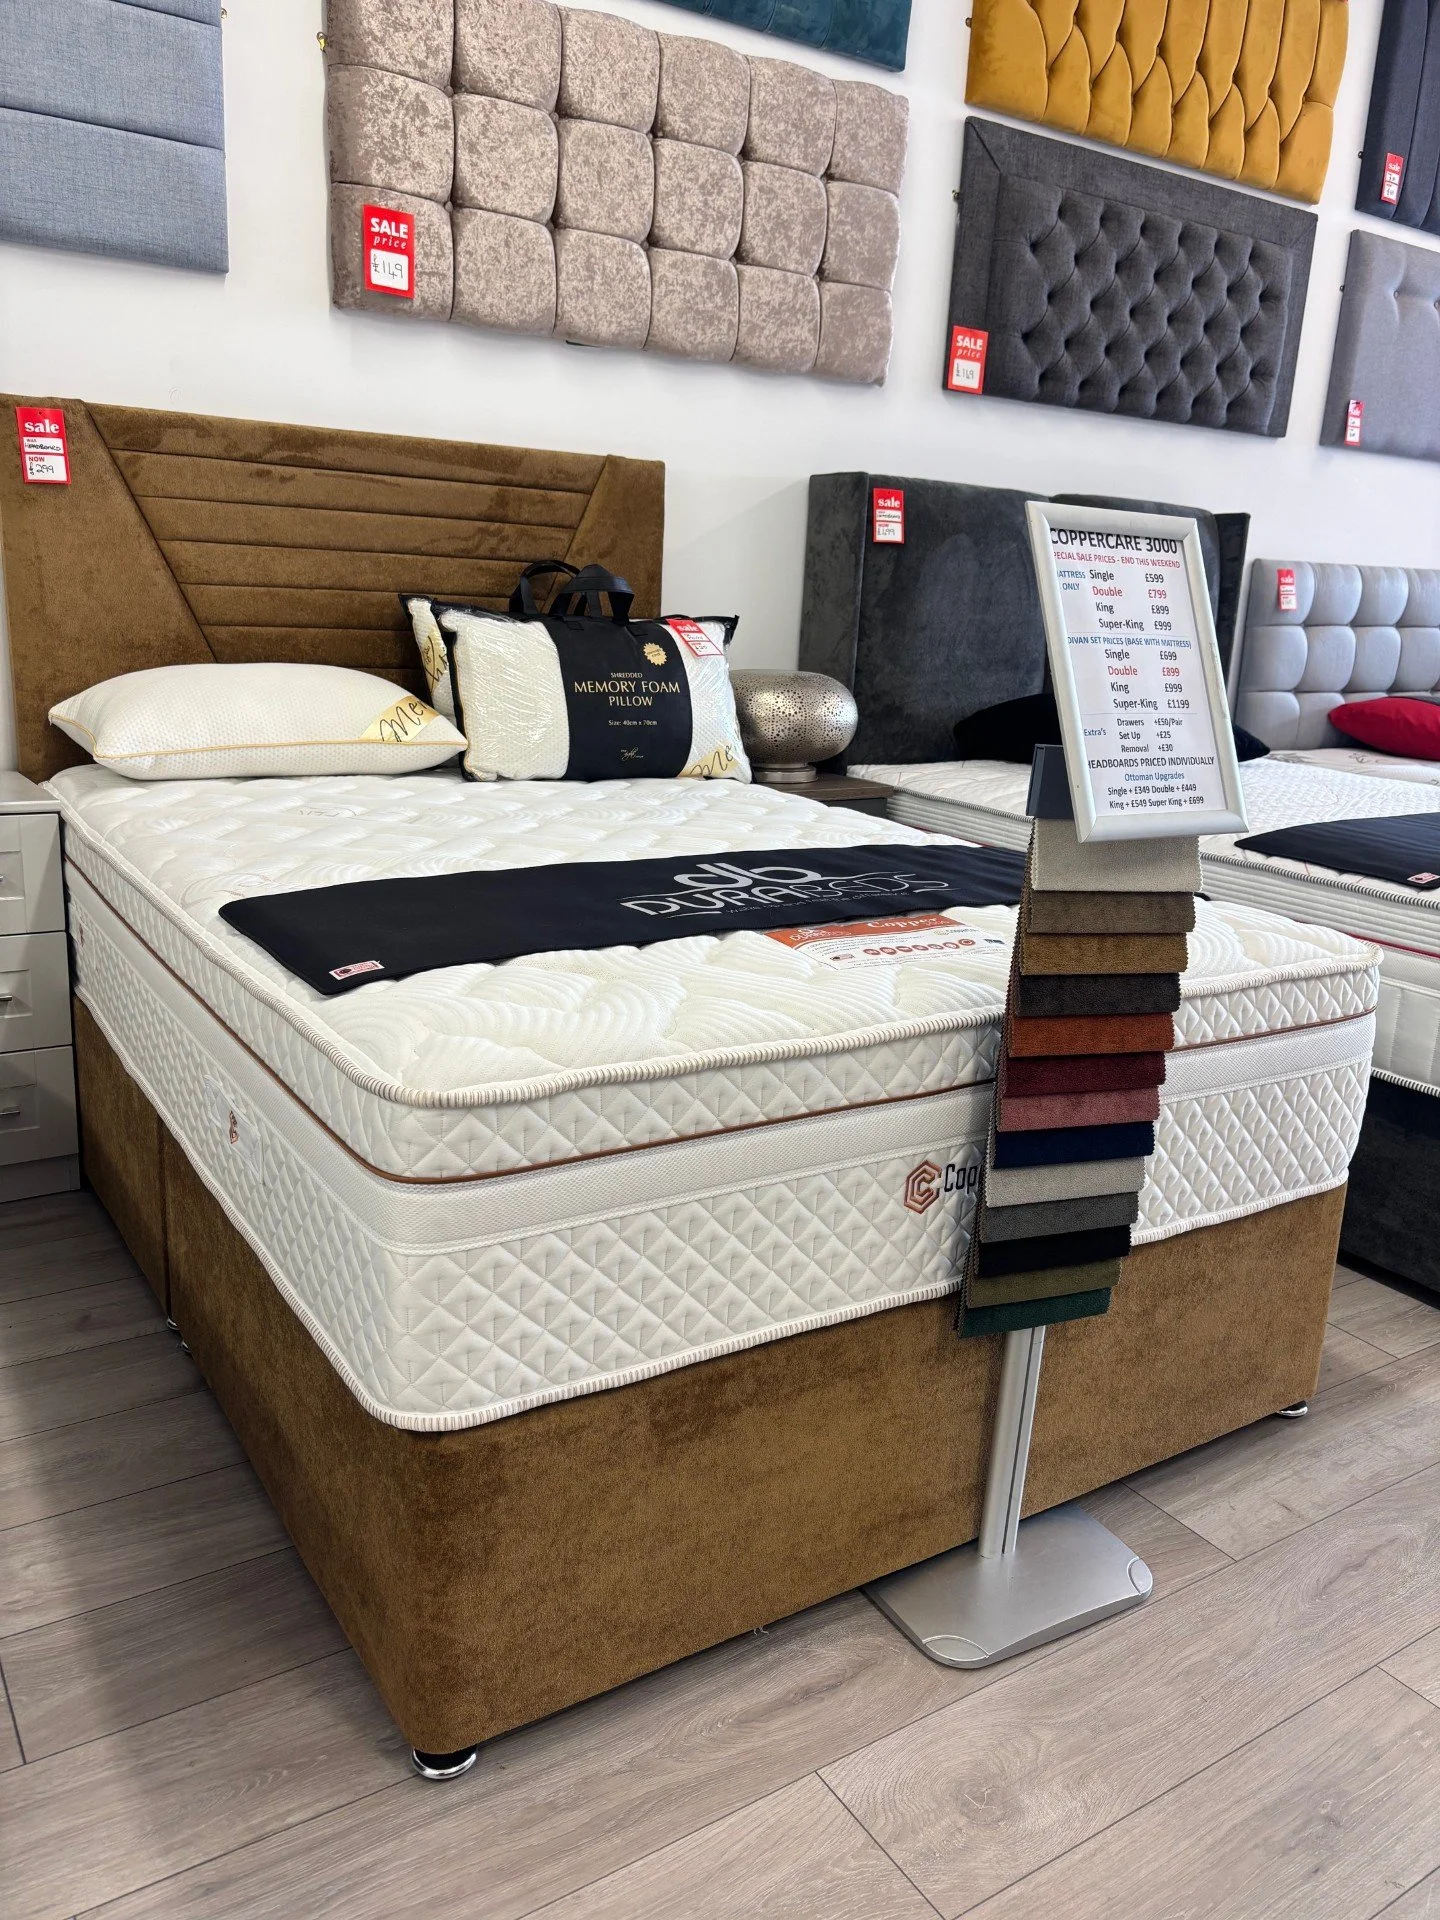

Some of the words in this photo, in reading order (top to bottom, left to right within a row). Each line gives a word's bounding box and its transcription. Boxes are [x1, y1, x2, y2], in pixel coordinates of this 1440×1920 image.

[370, 217, 408, 239] SALE
[373, 236, 407, 249] price
[956, 335, 984, 351] SALE
[956, 347, 981, 359] price
[24, 419, 60, 434] sale
[877, 496, 900, 508] sale
[1050, 528, 1142, 551] COPPERCARE
[1145, 537, 1178, 554] 3000
[1076, 553, 1093, 562] SALE
[1093, 555, 1116, 564] PRICES
[1120, 556, 1135, 565] END
[1135, 557, 1150, 566] THIS
[1150, 559, 1181, 569] WEEKEND
[1089, 569, 1115, 582] Single
[1145, 573, 1164, 583] £599
[1062, 583, 1080, 591] ONLY
[1092, 586, 1123, 597] Double
[1148, 589, 1167, 599] £799
[1095, 602, 1115, 615] King
[1151, 605, 1170, 615] £899
[1098, 618, 1145, 632] Super-King
[1154, 620, 1172, 631] £999
[1067, 636, 1090, 645] DIVAN
[1090, 636, 1101, 645] SET
[1102, 637, 1124, 646] PRICES
[1124, 637, 1143, 647] (BASE
[1143, 638, 1160, 647] WITH
[1160, 639, 1192, 650] MATTRESS)
[1104, 648, 1130, 661] Single
[1159, 650, 1177, 661] £699
[1107, 665, 1138, 676] Double
[1162, 666, 1180, 677] £899
[574, 680, 637, 693] MEMORY
[641, 681, 681, 694] FOAM
[1110, 681, 1130, 694] King
[1164, 682, 1183, 693] £999
[608, 695, 653, 707] PILLOW
[1112, 698, 1159, 711] Super-King
[1167, 699, 1190, 709] £1199
[608, 719, 622, 727] Size:
[622, 719, 638, 727] 40cm
[643, 719, 658, 727] 70cm
[1116, 718, 1145, 727] Drawers
[1153, 717, 1183, 728] +£50/Pair
[1083, 728, 1107, 737] Extra's
[1119, 731, 1130, 740] Set
[1130, 731, 1141, 741] Up
[1156, 730, 1172, 739] +£25
[1120, 743, 1150, 753] Removal
[1158, 743, 1174, 752] +£30
[1088, 758, 1139, 769] HEADBOARDS
[1140, 757, 1167, 767] PRICED
[1168, 756, 1215, 766] INDIVIDUALLY
[1124, 773, 1154, 782] Ottoman
[1154, 771, 1185, 782] Upgrades
[1107, 786, 1128, 798] Single
[1134, 785, 1151, 795] £349
[1151, 784, 1175, 794] Double
[1181, 783, 1197, 792] £449
[1109, 800, 1125, 811] King
[1131, 799, 1147, 808] £549
[1148, 798, 1168, 809] Super
[1167, 797, 1183, 808] King
[1188, 796, 1204, 805] £699
[620, 873, 951, 916] DURABEDS
[866, 917, 938, 928] Copper
